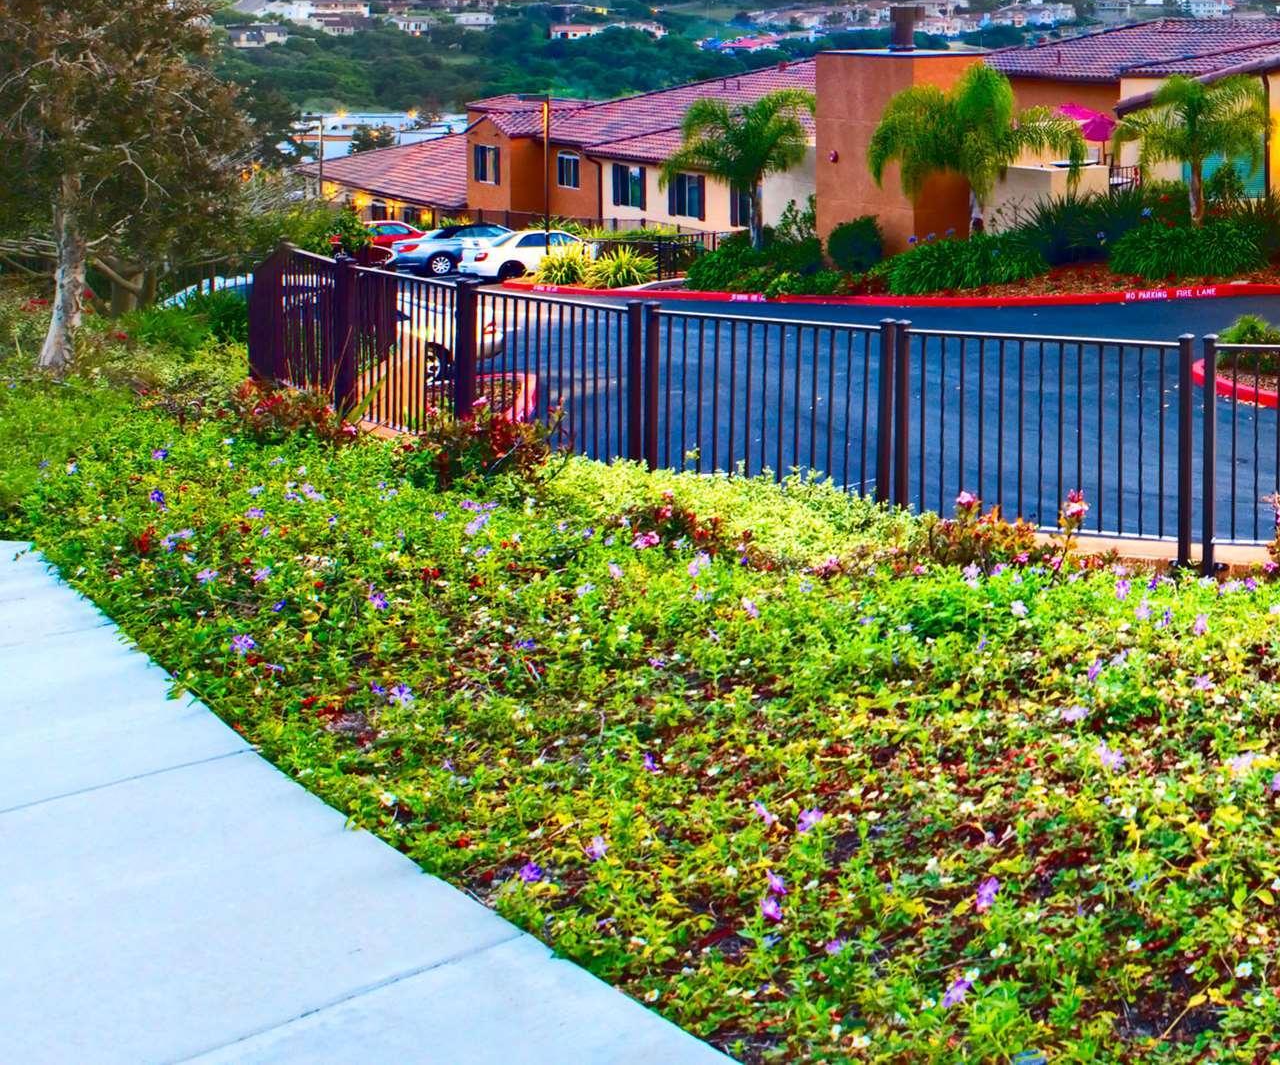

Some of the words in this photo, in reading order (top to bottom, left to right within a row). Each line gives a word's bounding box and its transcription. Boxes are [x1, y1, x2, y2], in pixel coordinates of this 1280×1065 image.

[1125, 292, 1136, 300] NO
[1138, 291, 1168, 299] PARKING
[1176, 289, 1193, 298] FIRE
[1196, 288, 1217, 296] LANE
